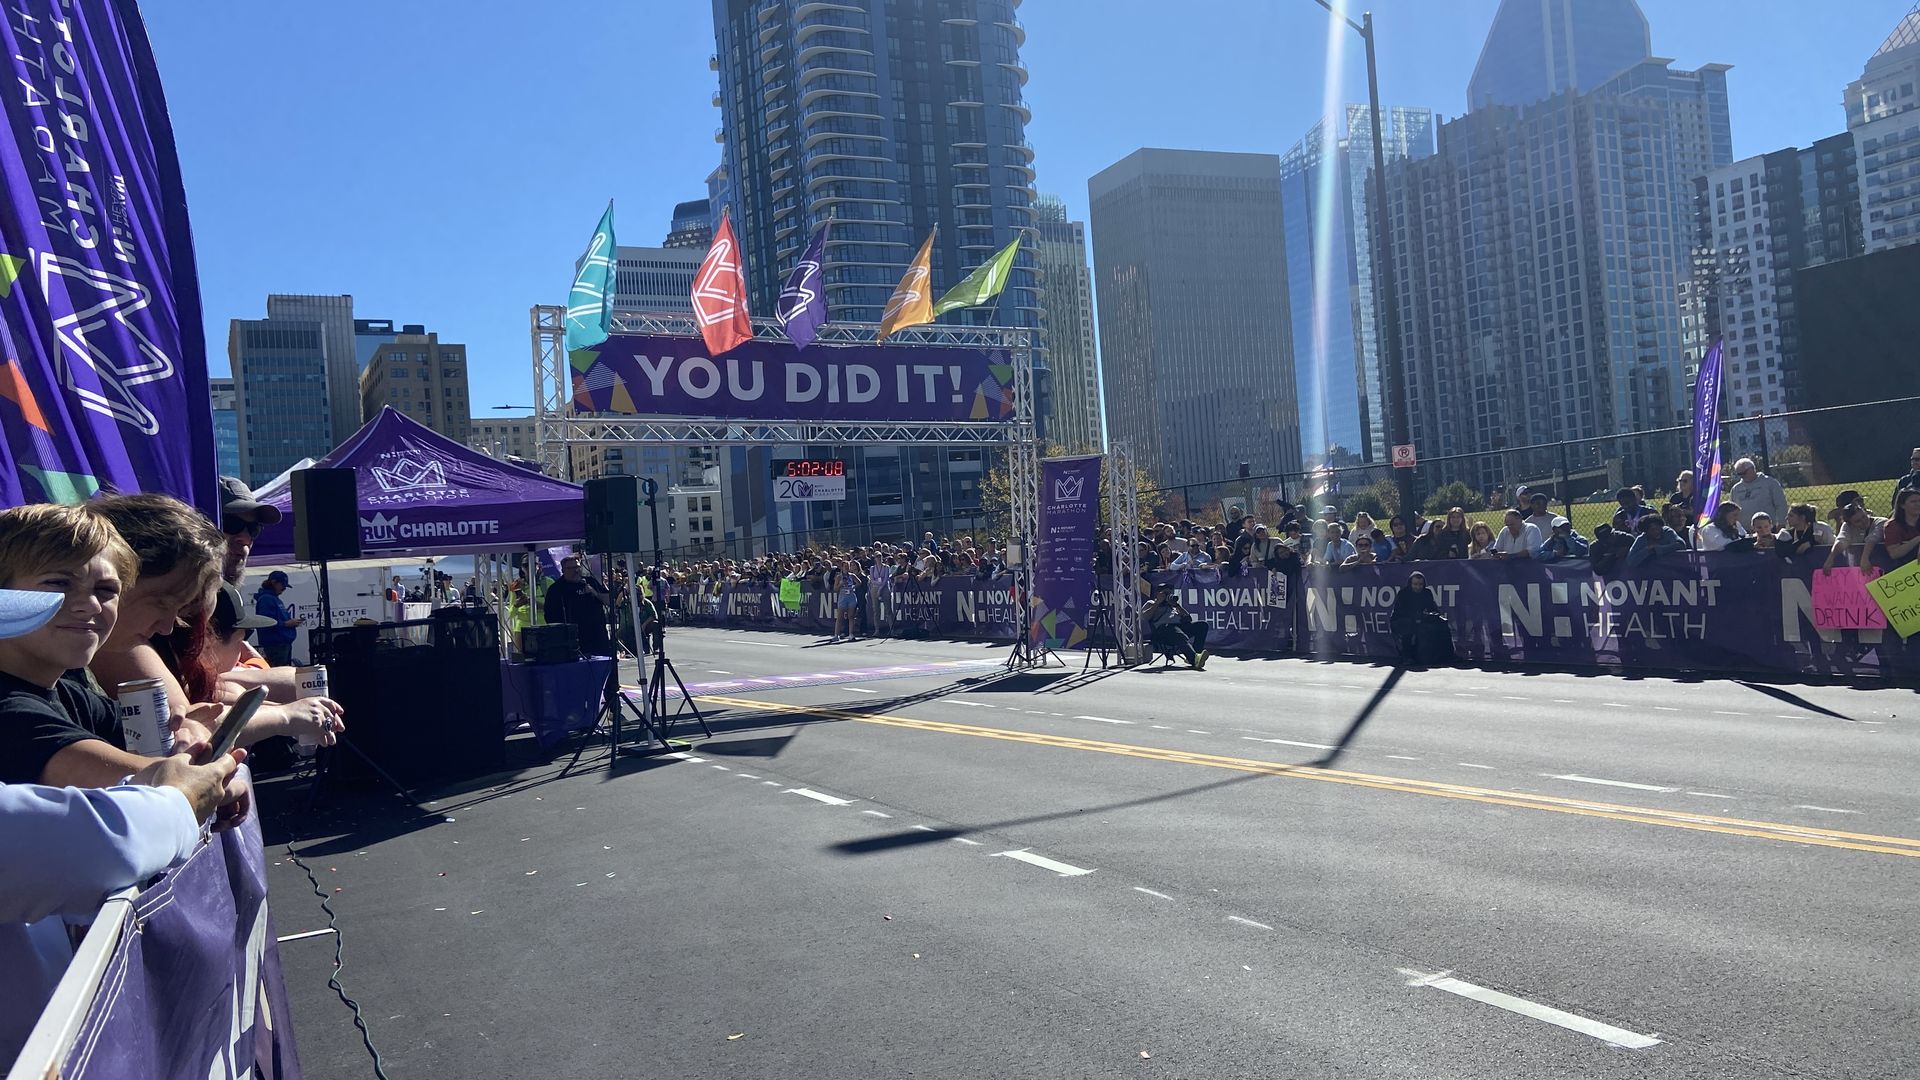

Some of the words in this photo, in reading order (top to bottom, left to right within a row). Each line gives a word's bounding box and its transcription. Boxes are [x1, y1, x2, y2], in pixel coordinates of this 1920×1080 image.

[633, 354, 765, 401] YOU
[785, 362, 880, 404] DID
[896, 365, 963, 403] IT!
[367, 488, 469, 502] CHARLOTTE
[1047, 503, 1087, 511] CHARLOTTE
[364, 524, 398, 540] RUN
[400, 519, 499, 538] CHARLOTTE
[1204, 588, 1269, 607] NOVAN
[1580, 579, 1721, 607] NOVANT
[299, 608, 367, 620] CHALOTTE
[1205, 611, 1271, 631] HEALTH
[1814, 607, 1881, 628] DRINK
[1583, 611, 1706, 640] HEALTH
